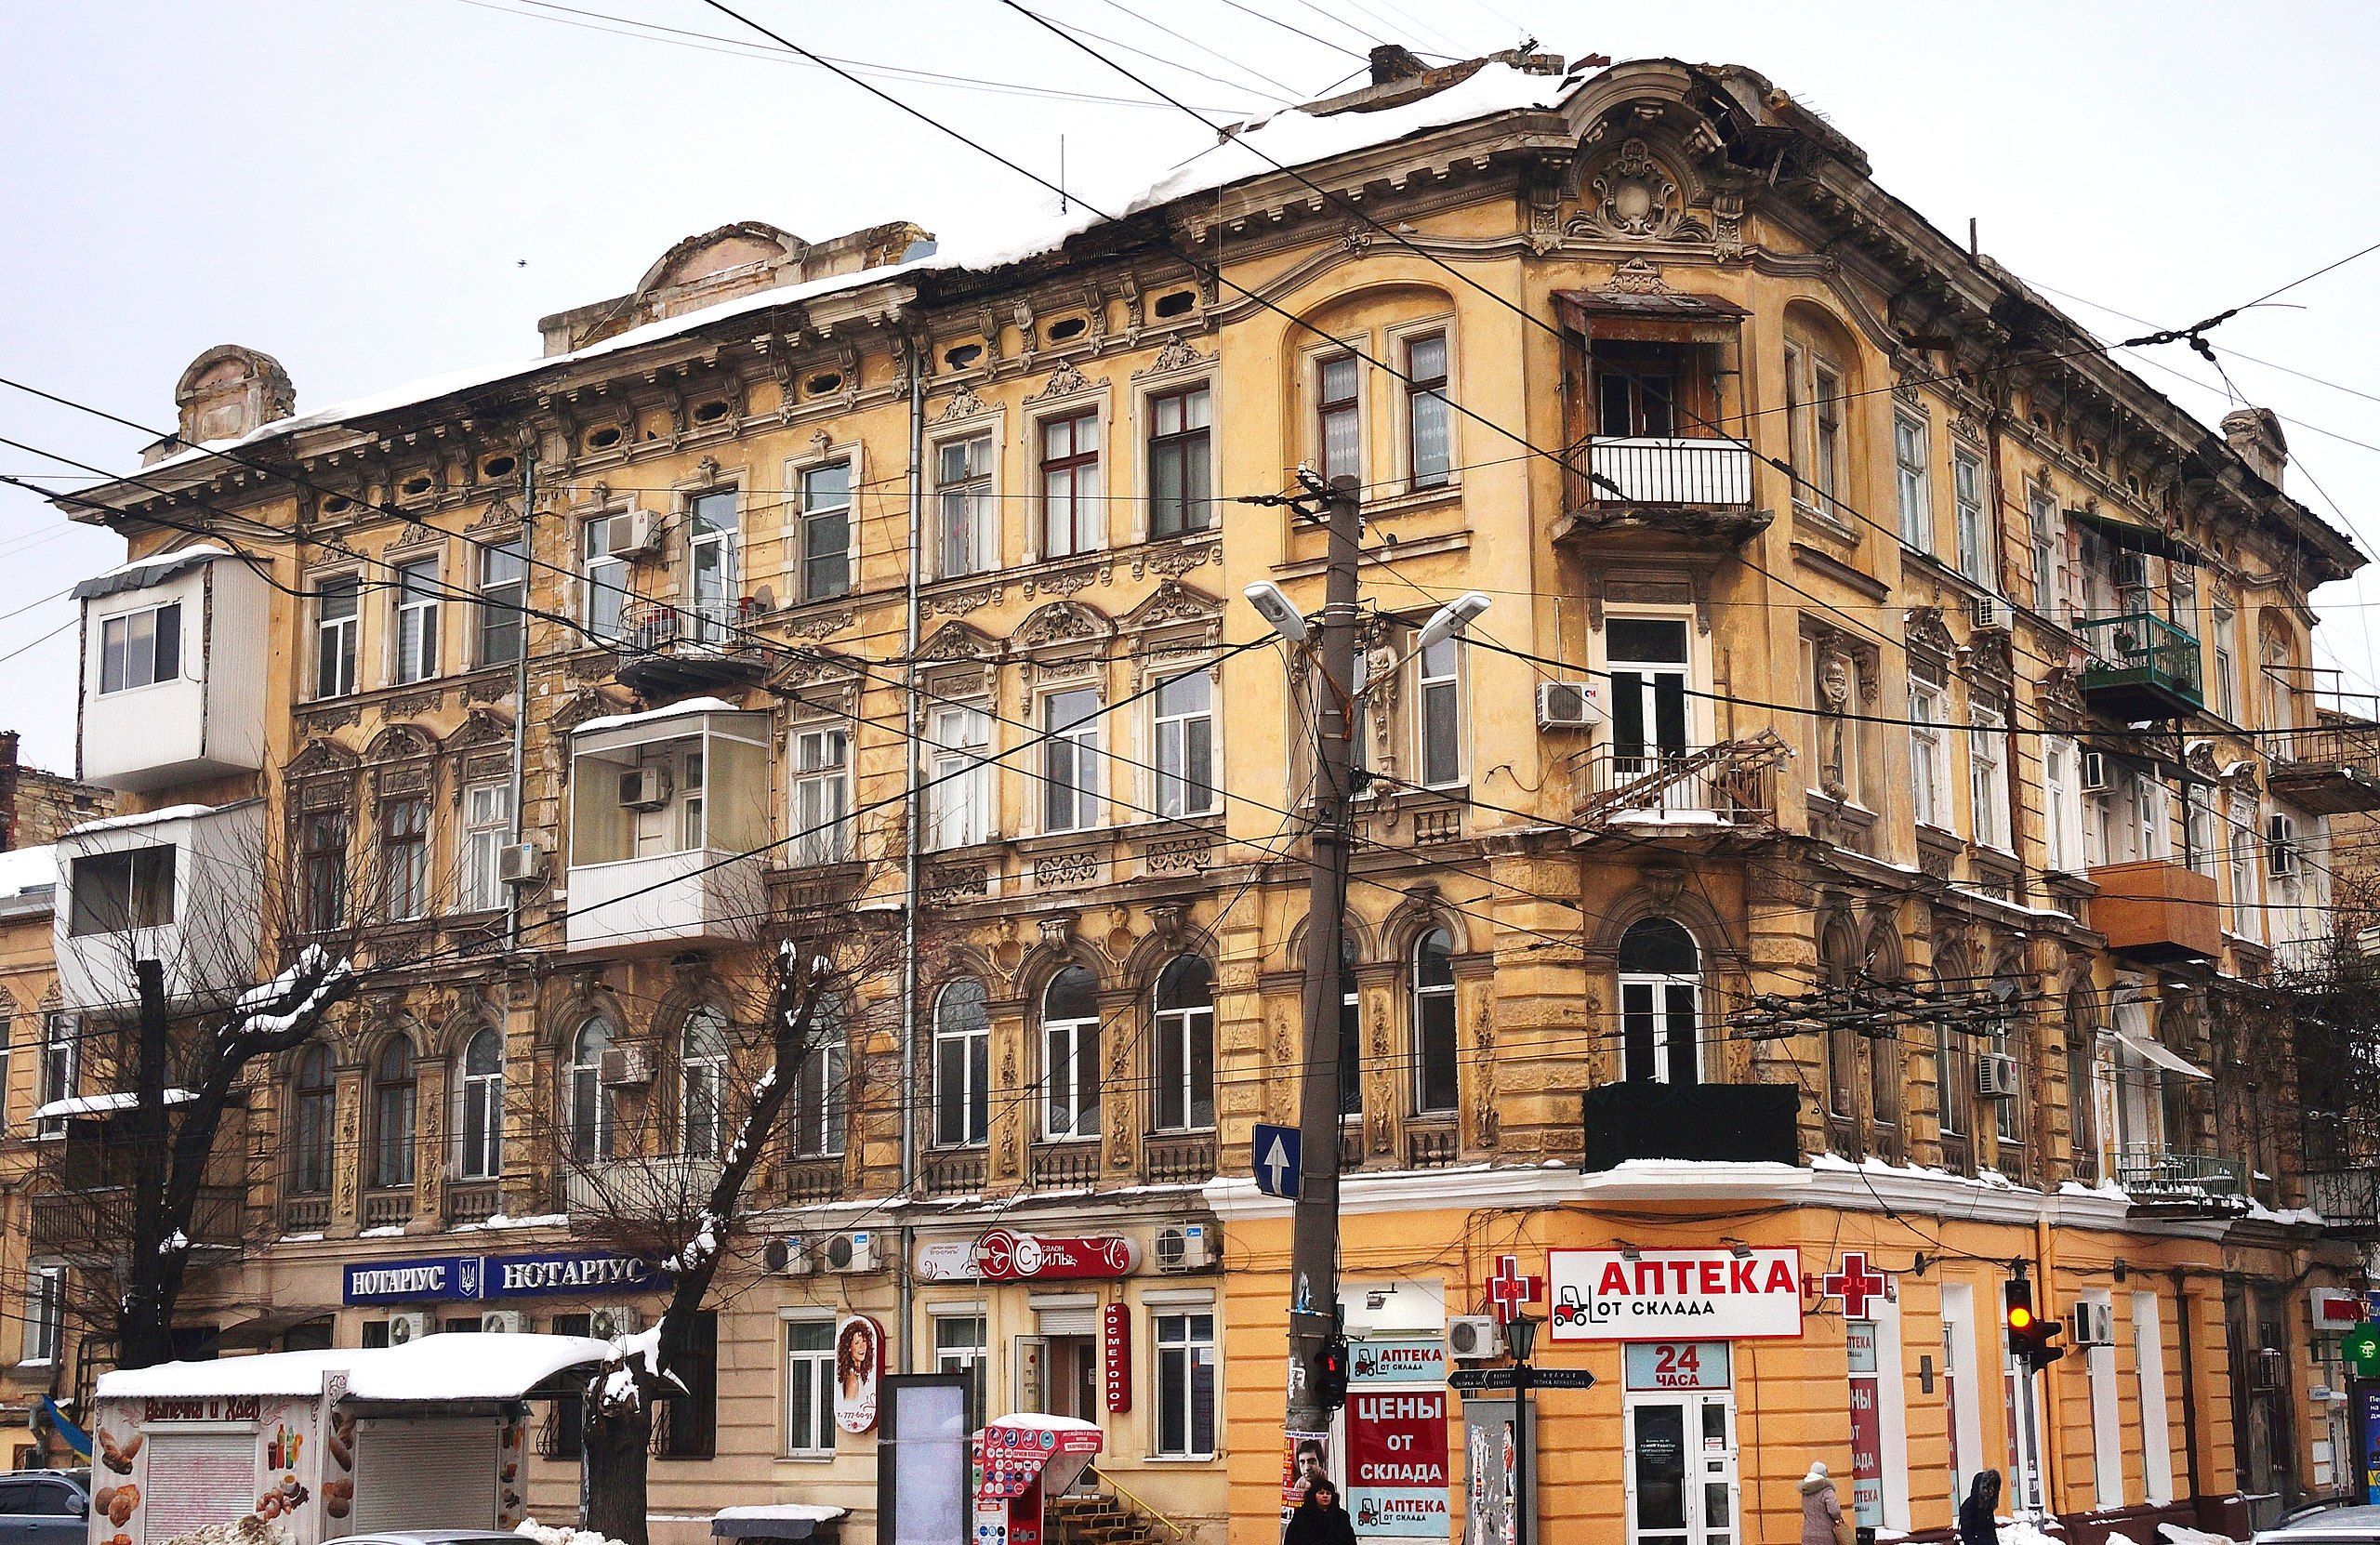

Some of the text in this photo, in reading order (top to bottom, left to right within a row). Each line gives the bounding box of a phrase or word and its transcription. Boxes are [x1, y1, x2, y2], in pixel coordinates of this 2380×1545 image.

[351, 1266, 446, 1295] НОТАРІУС
[502, 1258, 647, 1289] НОТАРІУС
[1597, 1260, 1796, 1296] АПТЕКА
[1841, 1276, 1867, 1295] 24
[1597, 1301, 1715, 1315] ОТ СКЛАДА
[1846, 1336, 1871, 1349] ПТЕКА
[1106, 1305, 1121, 1411] КОСМЕТОЛОГ
[1381, 1349, 1443, 1362] АПТЕКА
[1655, 1345, 1699, 1373] 24
[1656, 1374, 1699, 1386] ЧАСА
[144, 1395, 204, 1421] Выпечка
[210, 1402, 219, 1419] и
[1850, 1388, 1871, 1409] НЫ
[1359, 1397, 1442, 1423] ЦЕНЫ
[1387, 1434, 1413, 1450] ОТ
[1852, 1453, 1874, 1471] АДА
[1360, 1463, 1443, 1483] СКЛАДА
[1384, 1499, 1446, 1512] АПТЕКА
[1854, 1489, 1879, 1503] ПТЕКА
